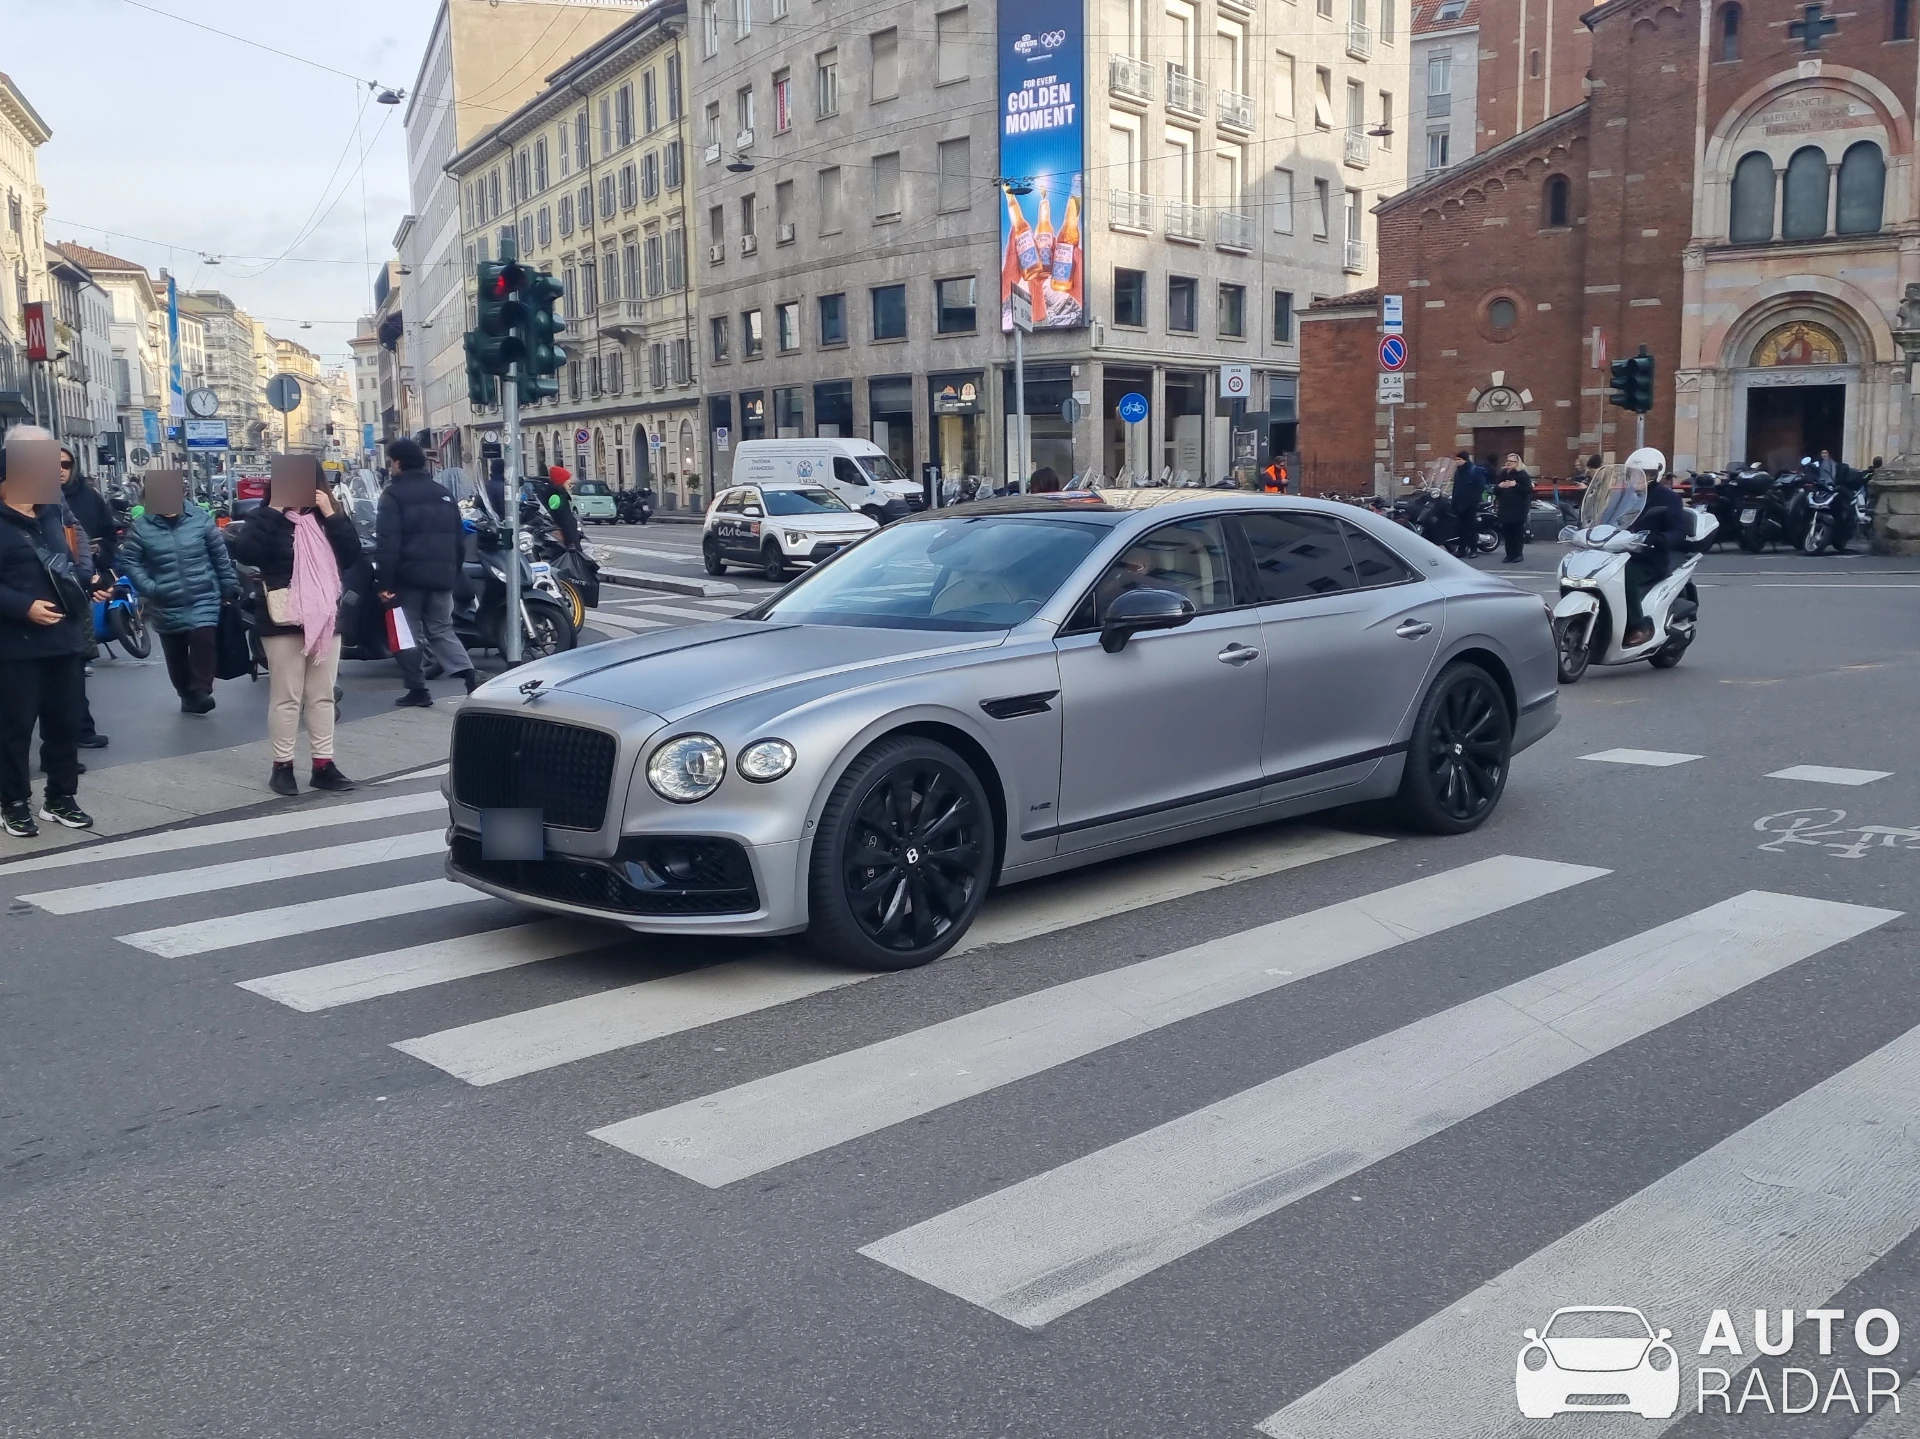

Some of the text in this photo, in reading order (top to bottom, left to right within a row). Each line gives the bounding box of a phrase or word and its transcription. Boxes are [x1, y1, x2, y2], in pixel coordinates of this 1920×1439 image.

[1023, 75, 1058, 89] FOR EVERY
[1007, 83, 1071, 113] GOLDEN
[1005, 104, 1076, 135] MOMENT
[29, 317, 45, 350] M
[1232, 380, 1240, 388] 30
[718, 526, 735, 537] KIA
[906, 848, 919, 864] B
